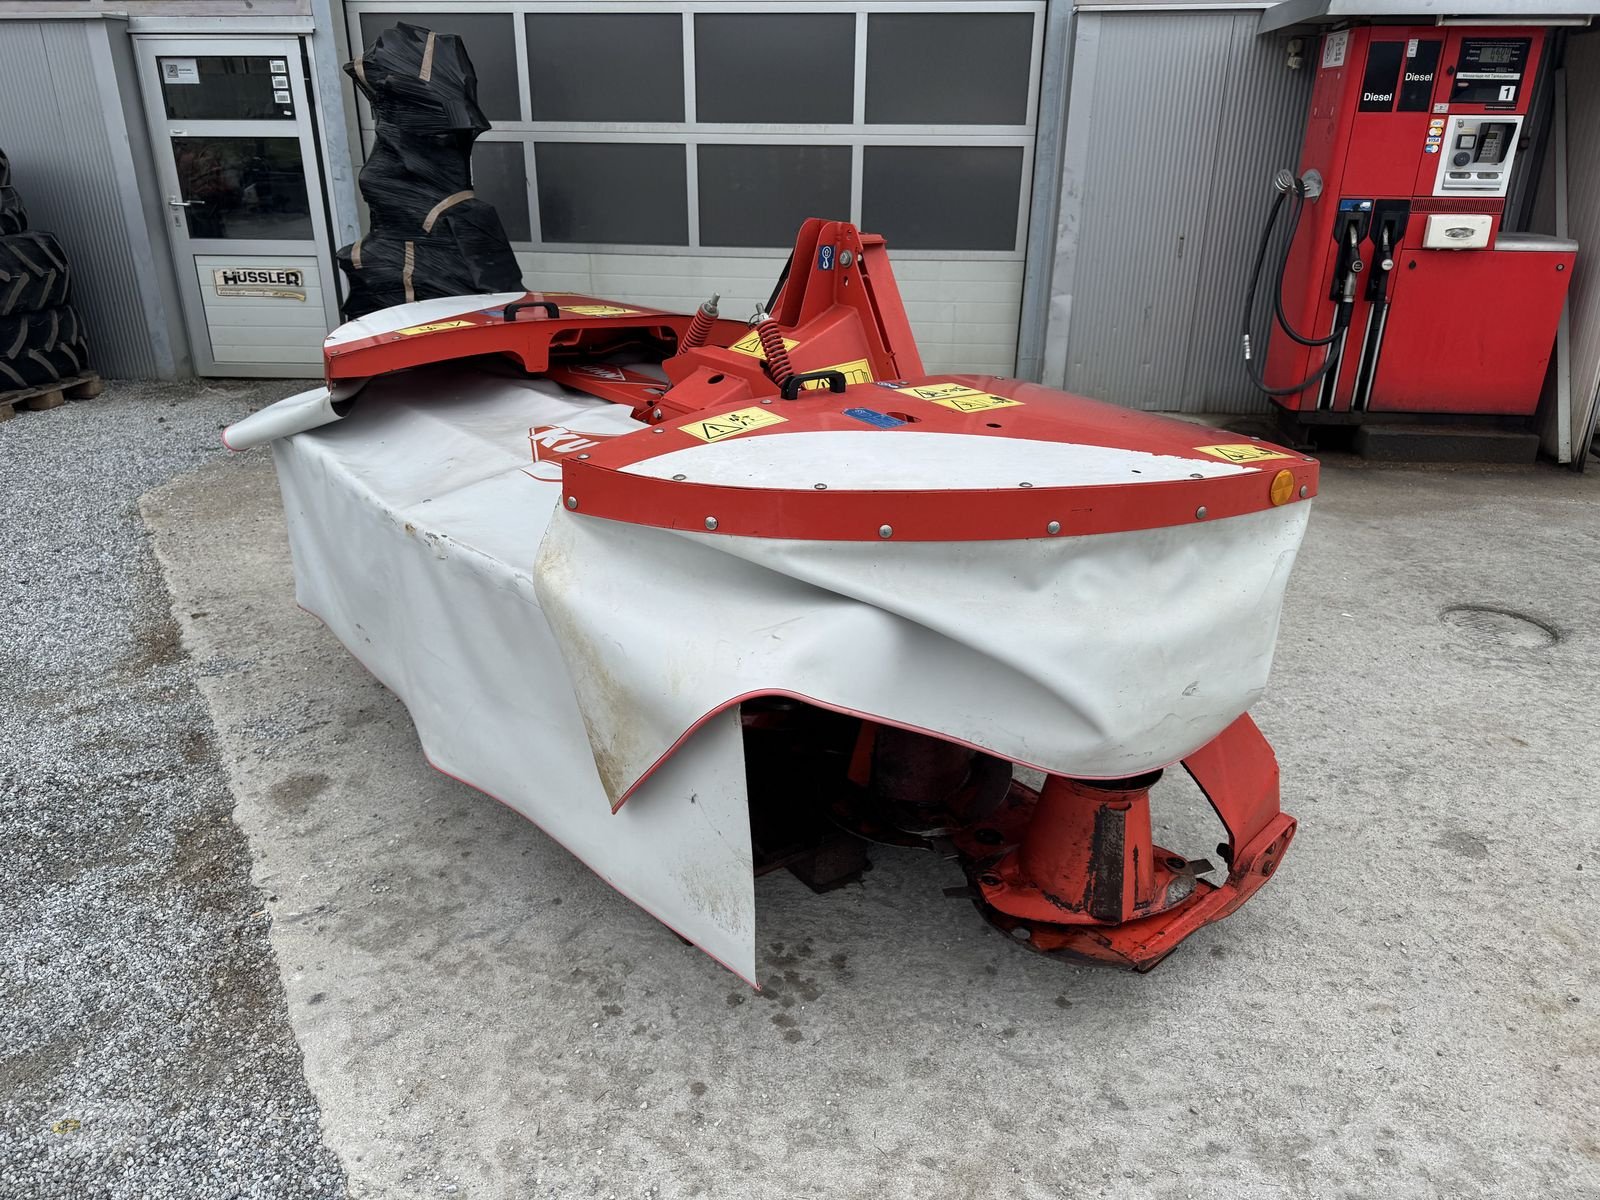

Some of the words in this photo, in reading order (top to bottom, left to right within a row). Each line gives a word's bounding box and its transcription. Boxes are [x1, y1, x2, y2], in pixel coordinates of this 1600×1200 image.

[1405, 72, 1433, 81] Diesel
[1363, 92, 1392, 101] Diesel
[1504, 87, 1511, 99] 1
[223, 271, 299, 286] HÜSSLER
